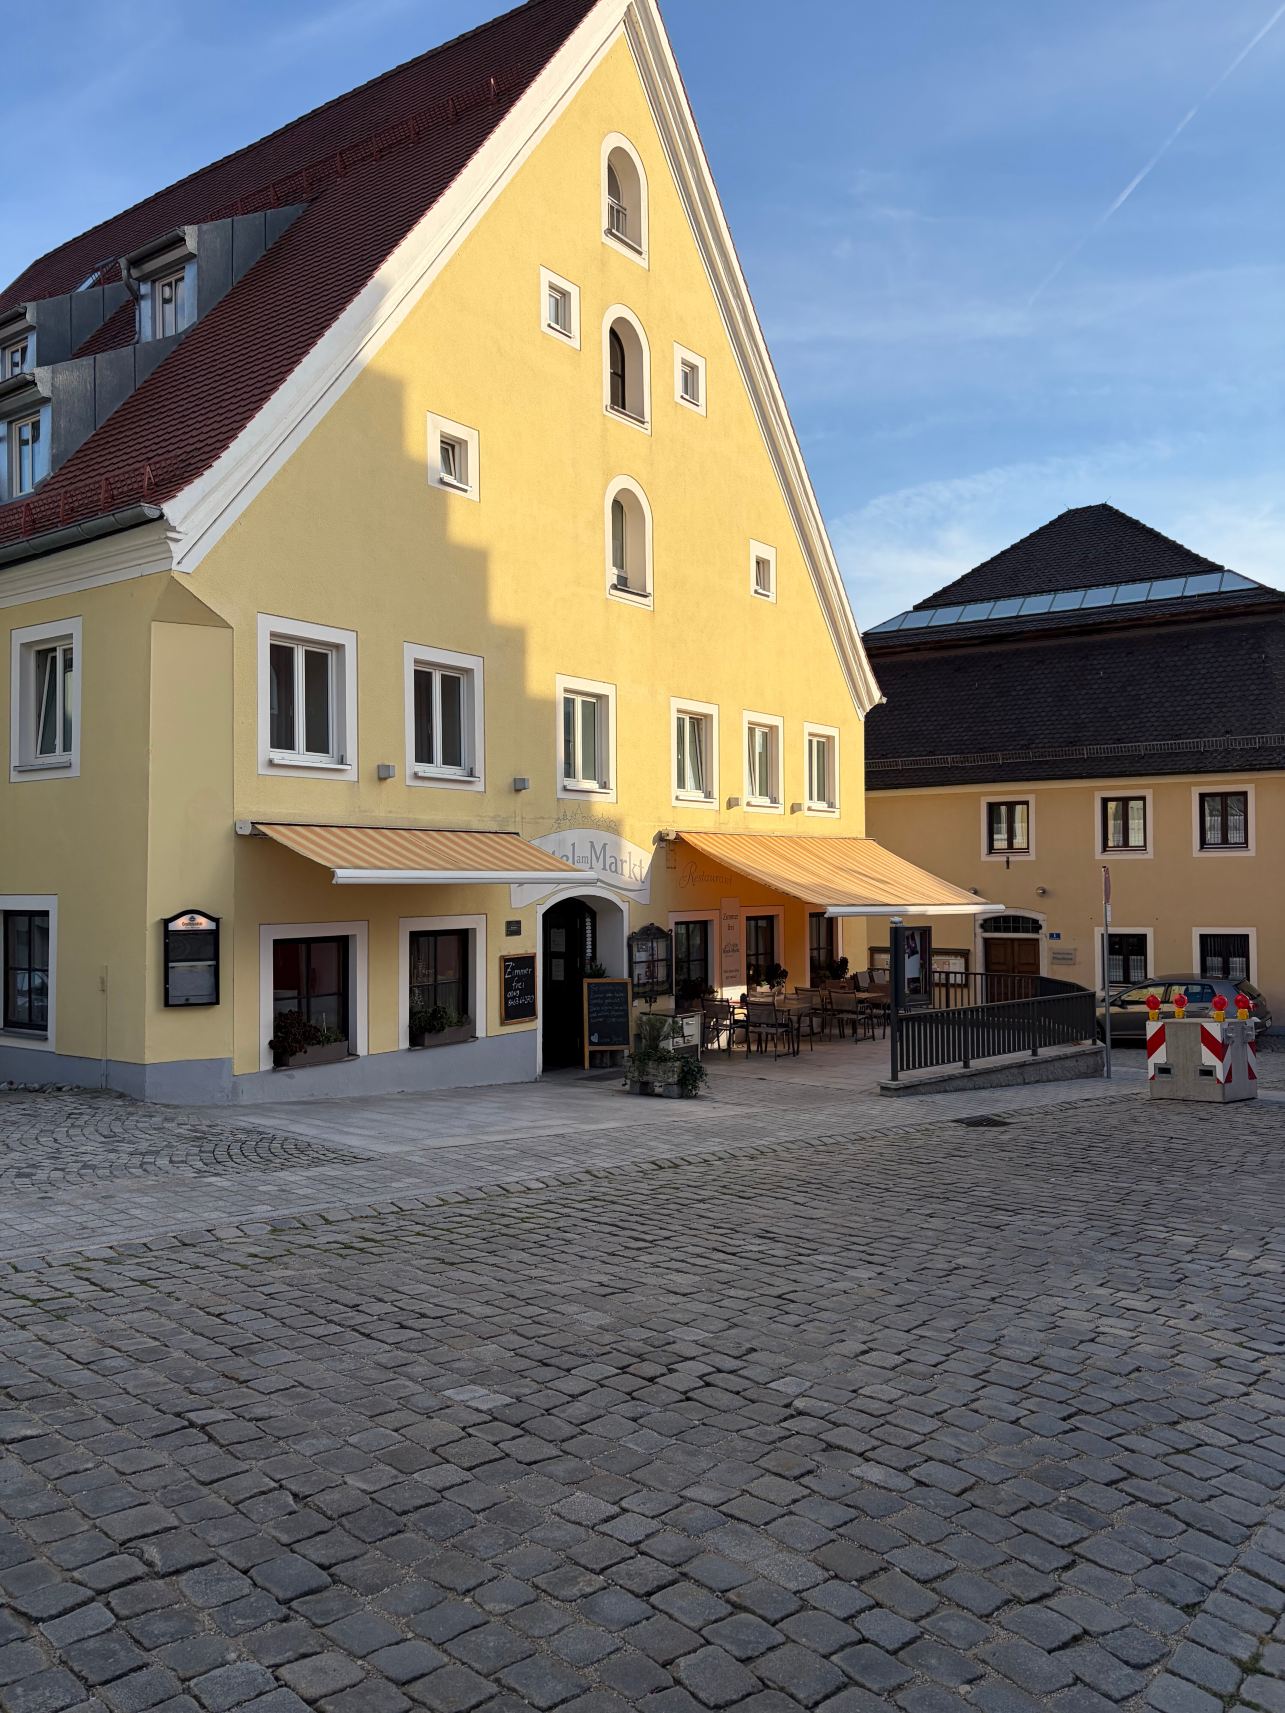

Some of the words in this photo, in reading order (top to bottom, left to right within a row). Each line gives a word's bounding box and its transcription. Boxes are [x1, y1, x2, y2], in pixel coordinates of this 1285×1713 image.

[576, 854, 590, 865] am
[588, 841, 645, 884] Markt
[678, 861, 733, 889] Restaurant
[505, 962, 533, 979] Zimmer
[512, 977, 525, 991] frei
